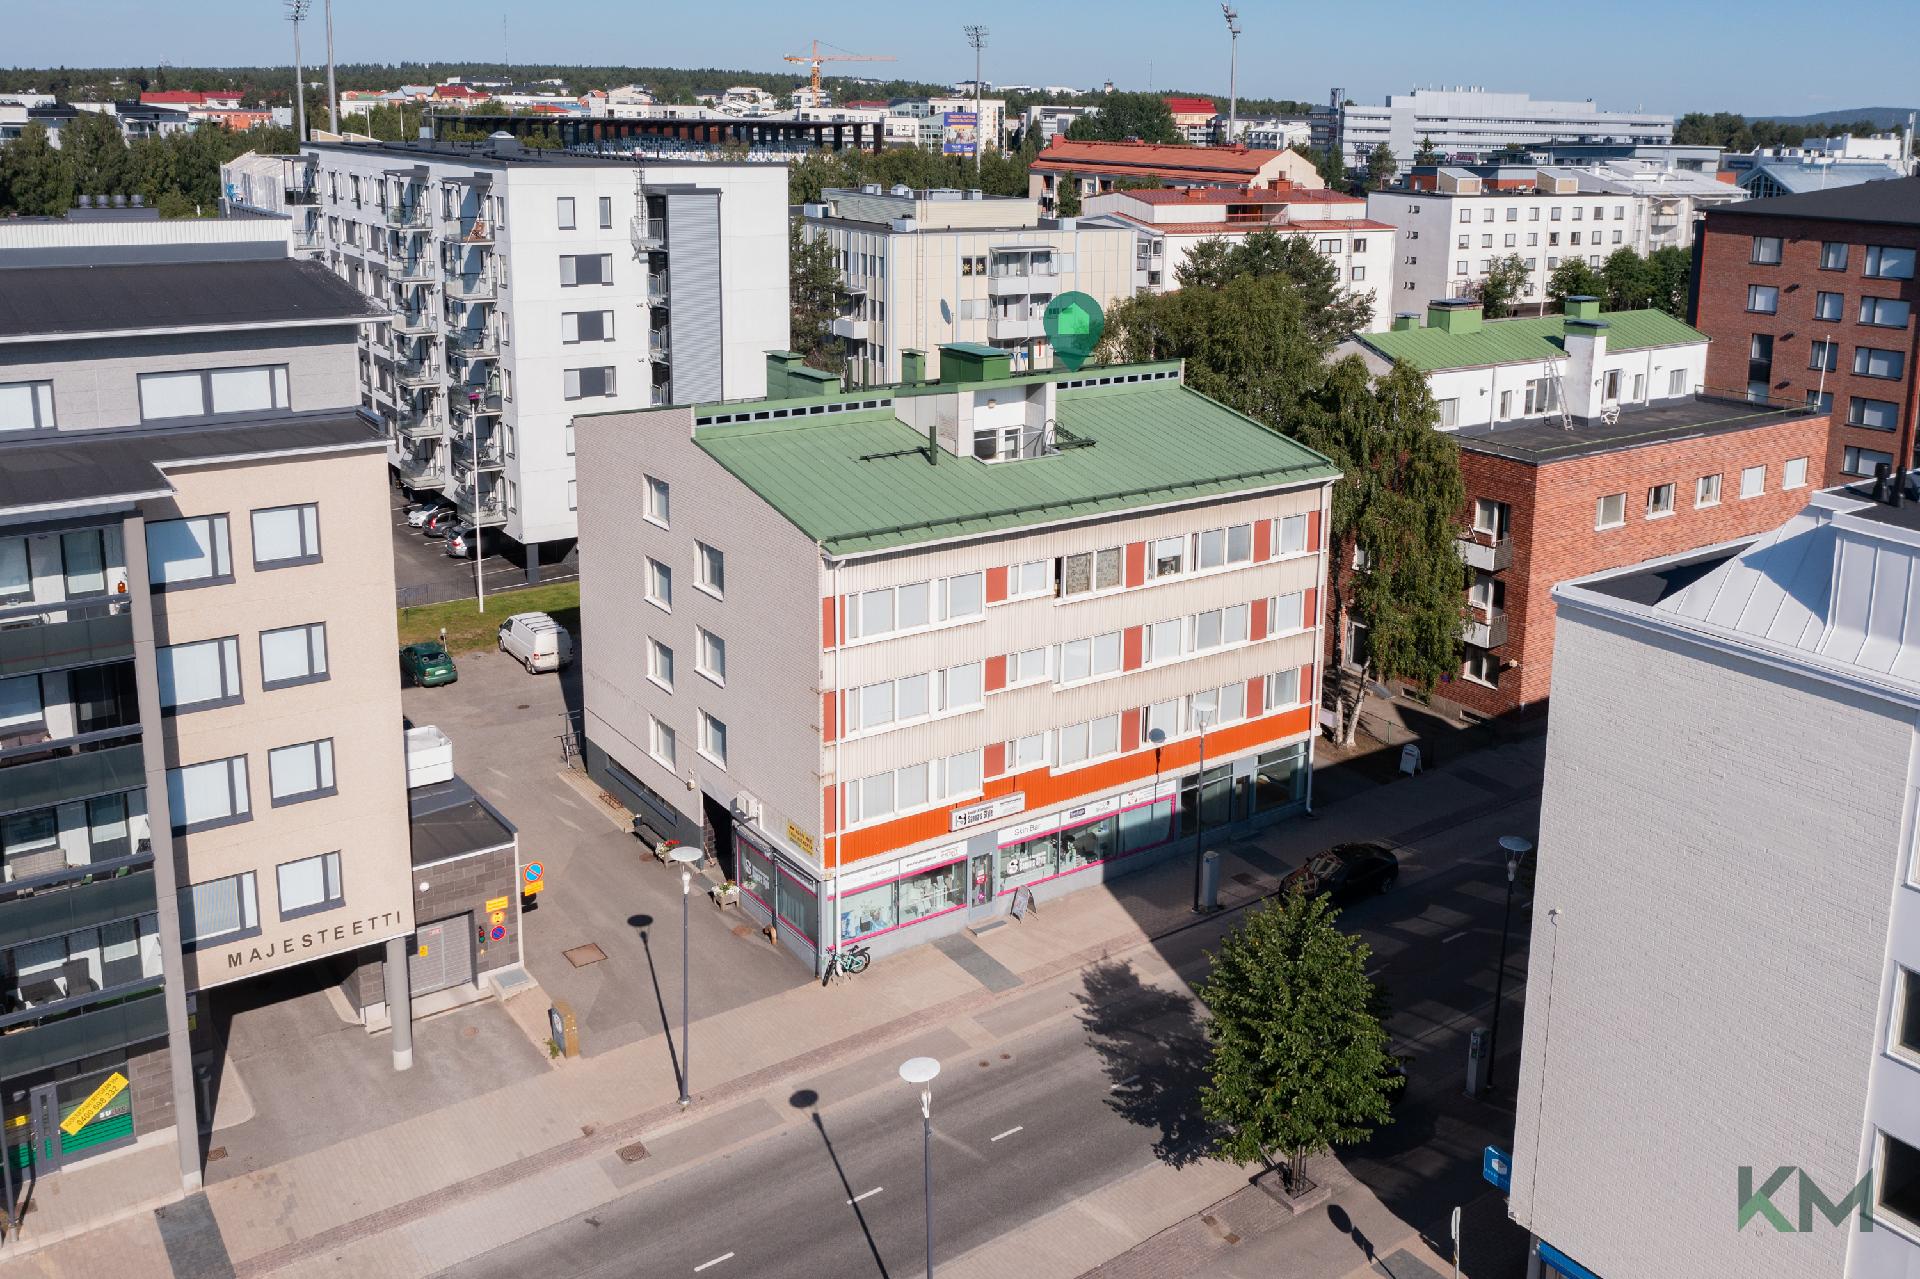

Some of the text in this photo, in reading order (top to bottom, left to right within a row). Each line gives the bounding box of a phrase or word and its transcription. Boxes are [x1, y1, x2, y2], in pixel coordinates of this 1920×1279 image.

[1014, 824, 1041, 836] Skin Bar
[227, 911, 401, 968] MAJESTEETTI
